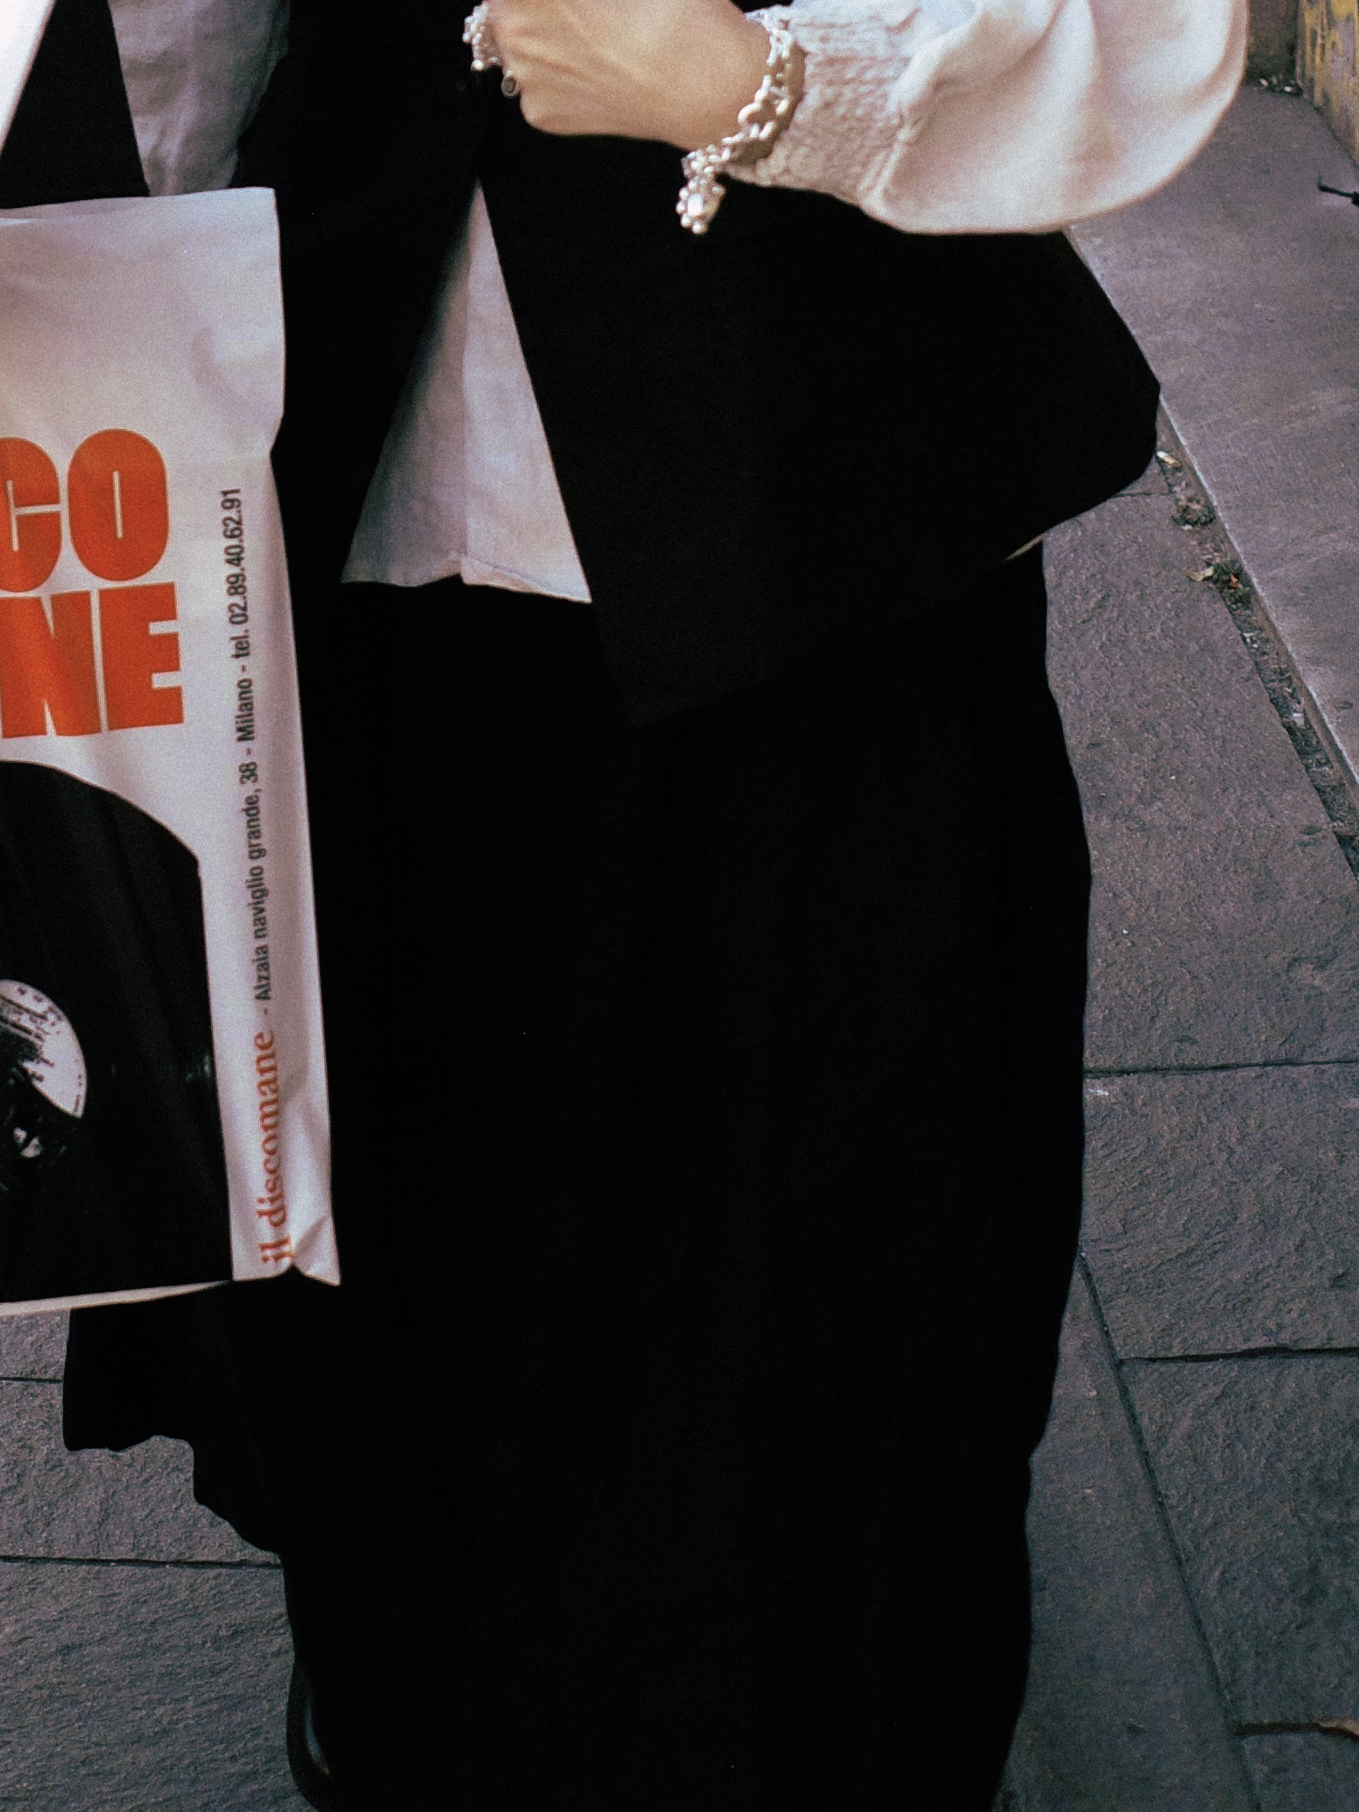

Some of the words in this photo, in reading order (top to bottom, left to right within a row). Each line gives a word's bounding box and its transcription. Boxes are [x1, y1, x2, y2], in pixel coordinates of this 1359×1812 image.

[219, 488, 250, 626] 02.89.40.62.91
[229, 629, 251, 660] tel.
[234, 677, 256, 743] Milano
[238, 761, 259, 786] 38
[240, 787, 268, 861] grande,
[246, 865, 270, 940] naviglio
[251, 943, 273, 1002] Alzaia
[254, 1029, 288, 1228] discomane
